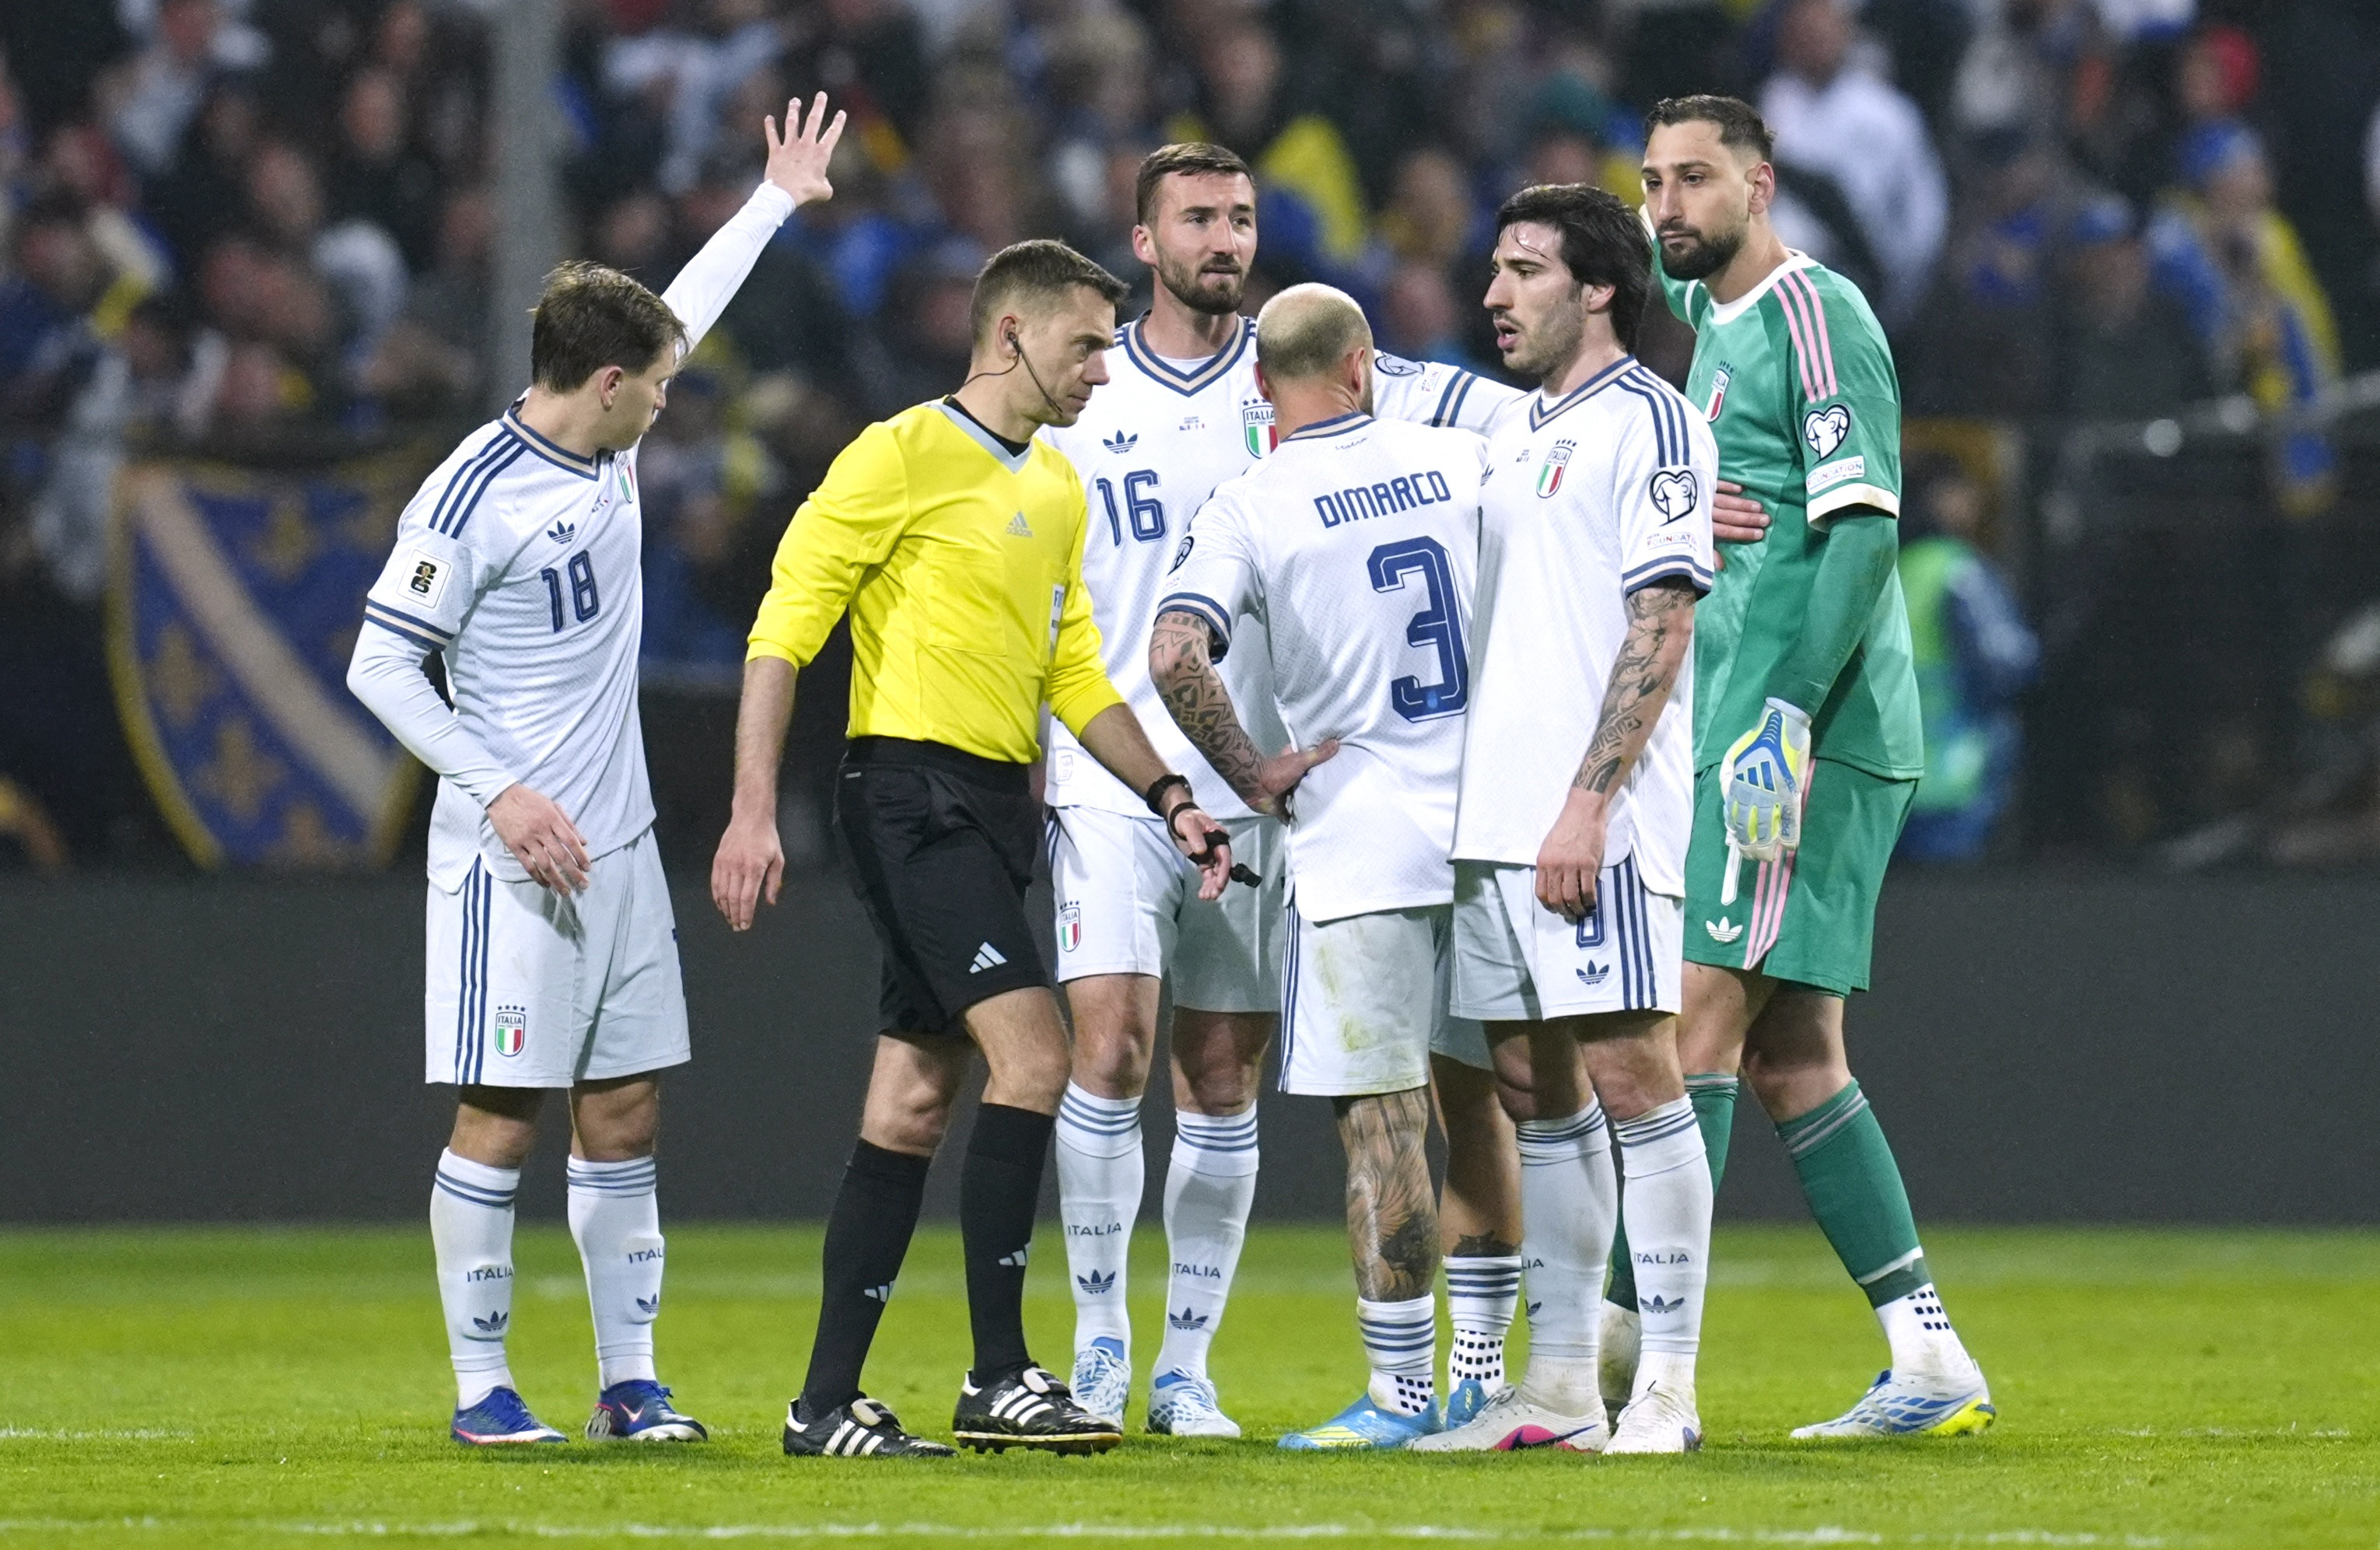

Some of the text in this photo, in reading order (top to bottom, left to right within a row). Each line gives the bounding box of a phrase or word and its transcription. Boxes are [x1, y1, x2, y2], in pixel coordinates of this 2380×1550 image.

[1246, 409, 1275, 421] ITALIA
[1807, 462, 1863, 487] FOUNDATION
[1313, 470, 1451, 529] DIMARCO
[1095, 469, 1167, 548] 16
[1006, 527, 1034, 537] adidas
[541, 549, 600, 634] 18
[1367, 535, 1470, 723] 3
[498, 1015, 523, 1024] ITALIA
[1068, 1222, 1122, 1236] ITALIA
[628, 1247, 663, 1265] ITAL
[1521, 1258, 1545, 1269] LIA
[1634, 1252, 1689, 1265] ITALIA
[467, 1266, 514, 1282] ITALIA
[1172, 1262, 1221, 1279] ITALIA
